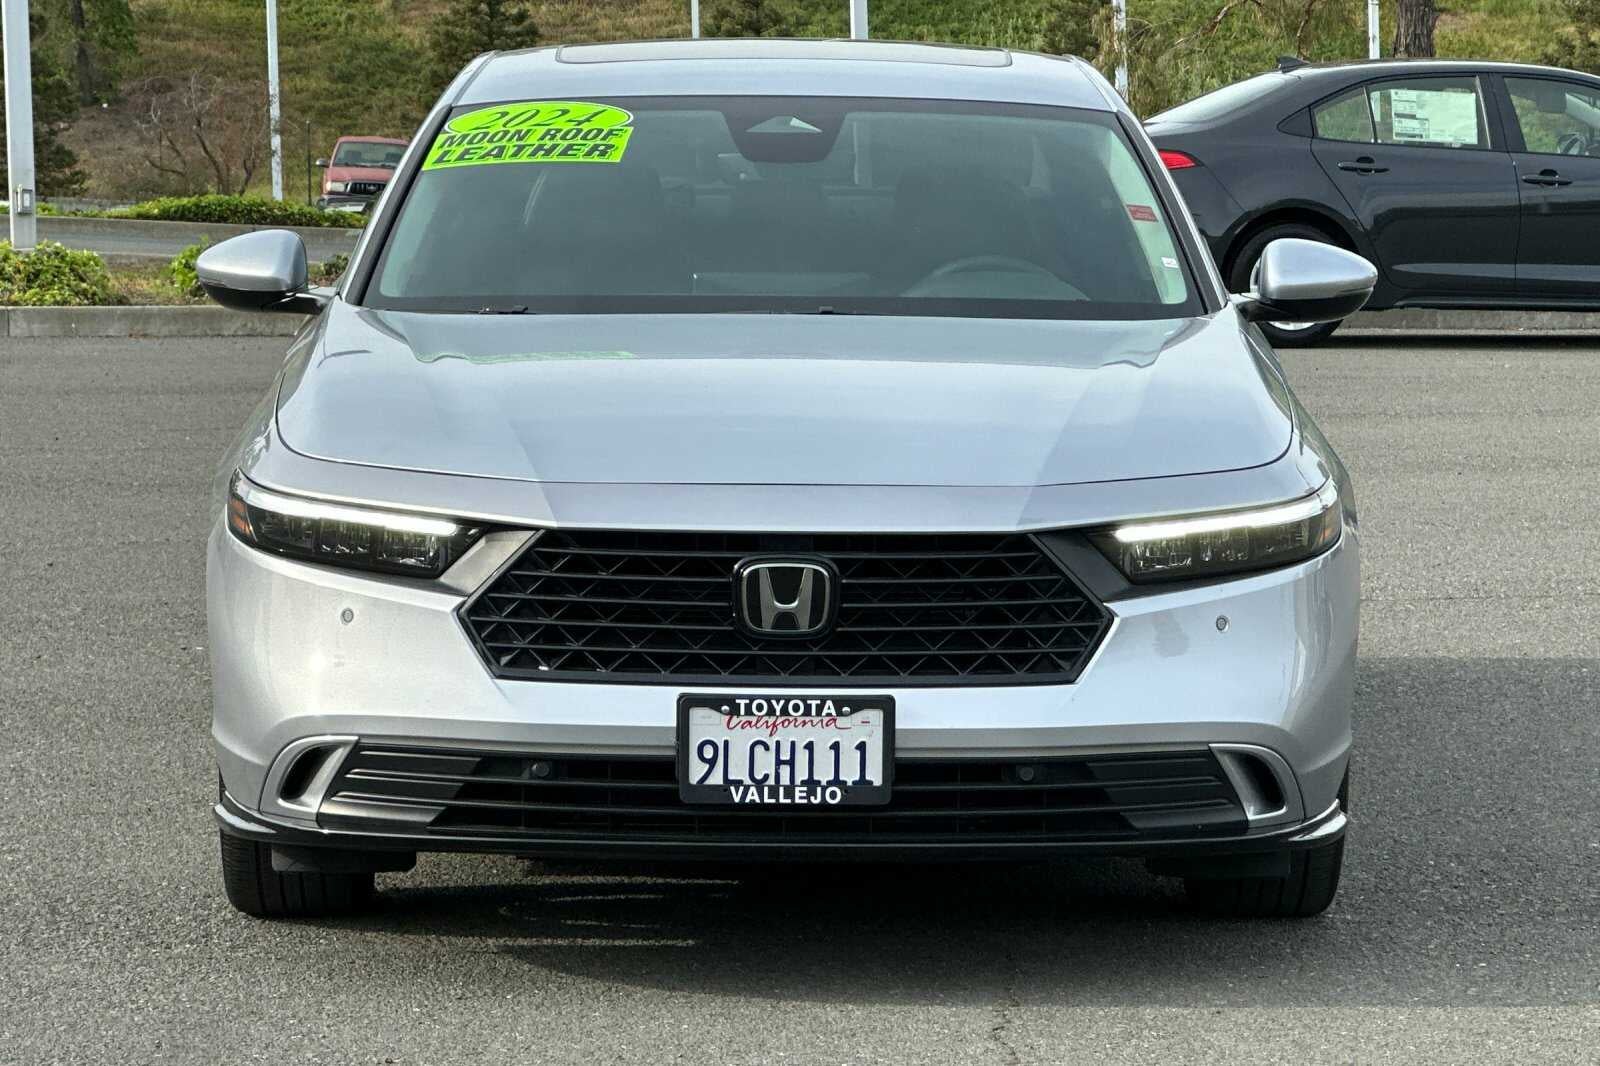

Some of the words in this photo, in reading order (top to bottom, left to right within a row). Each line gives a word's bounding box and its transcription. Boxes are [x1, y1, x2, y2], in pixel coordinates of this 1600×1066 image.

[468, 108, 608, 131] 2024
[439, 128, 531, 149] MOON
[537, 127, 625, 143] ROOF
[432, 143, 616, 165] LEATHER
[735, 699, 837, 716] TOYOTA
[725, 714, 852, 738] California
[696, 739, 874, 785] 9LCH111
[729, 786, 842, 804] VALLEJO
